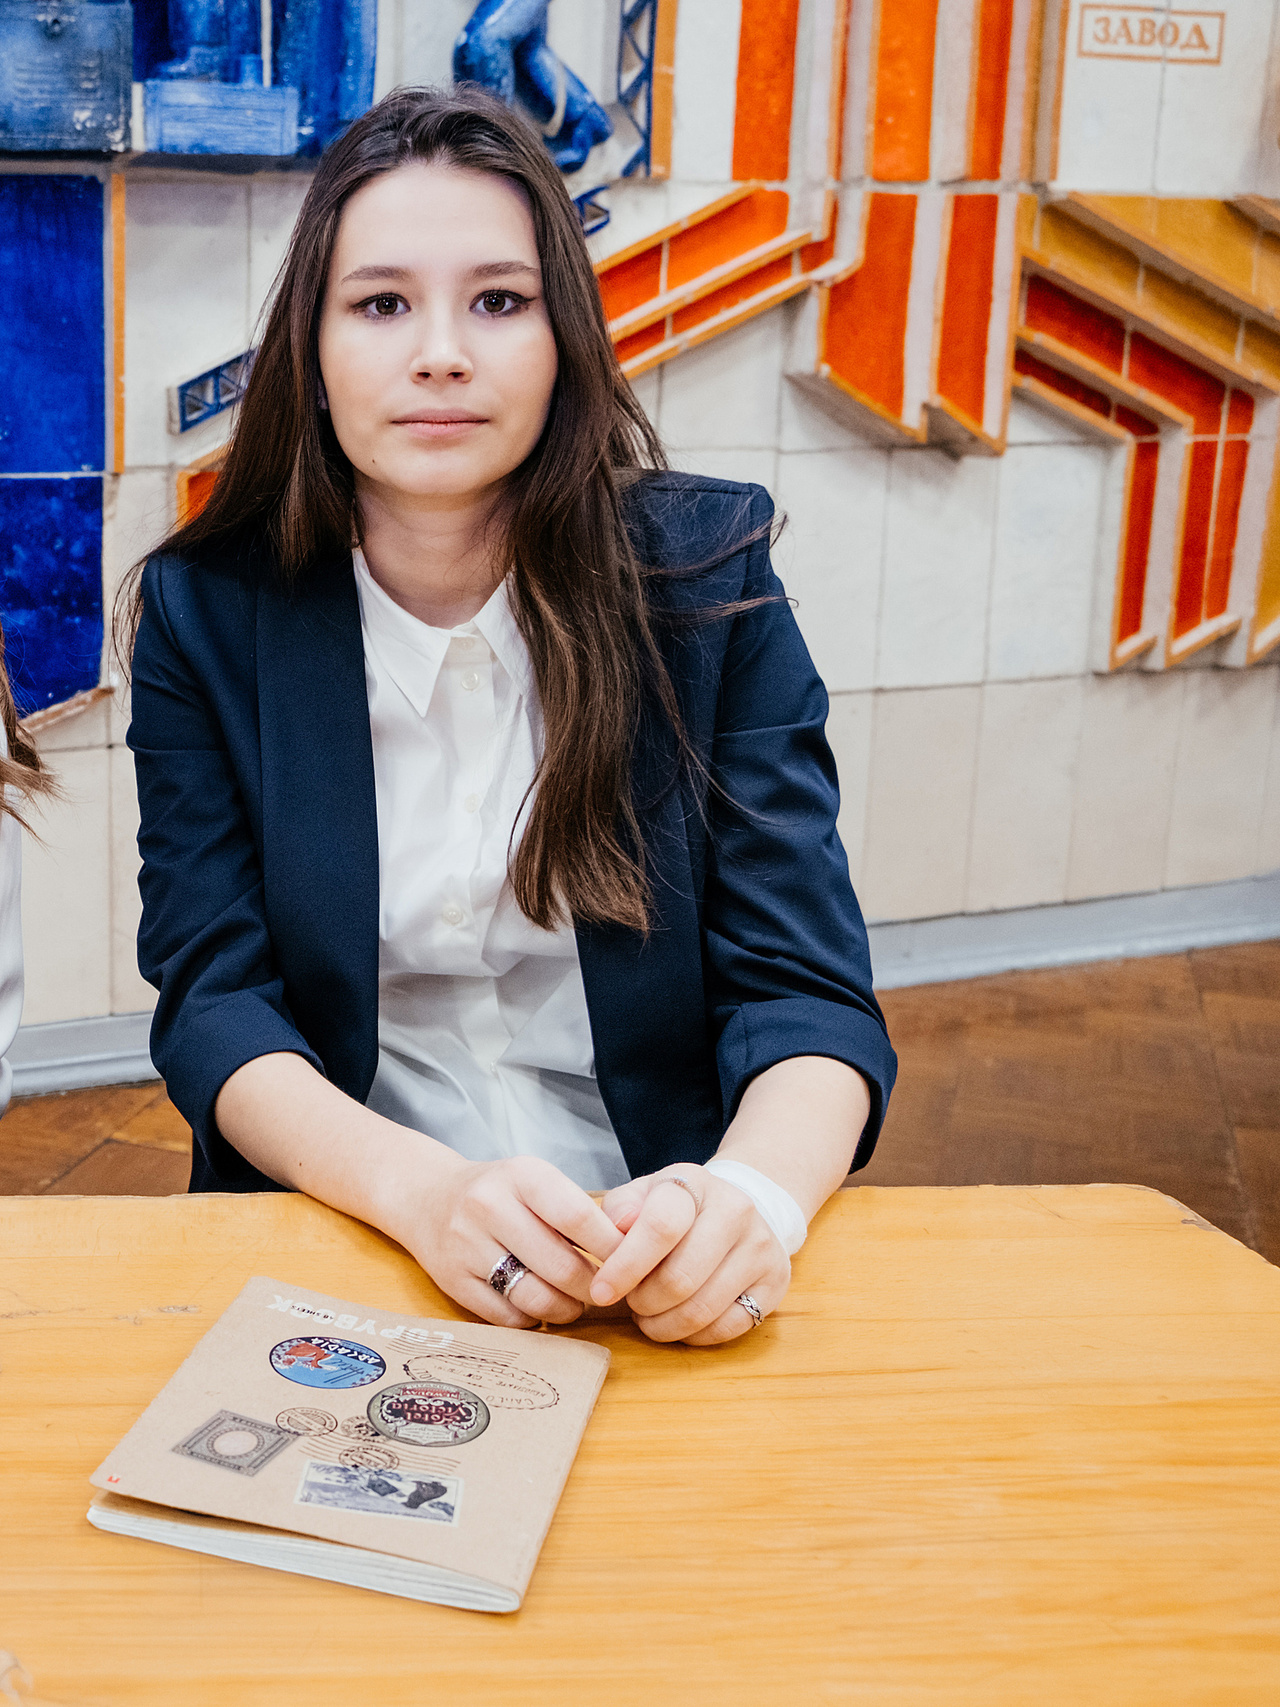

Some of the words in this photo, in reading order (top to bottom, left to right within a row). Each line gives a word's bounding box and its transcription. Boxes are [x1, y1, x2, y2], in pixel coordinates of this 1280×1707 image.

[1093, 16, 1210, 51] ЗАВОД
[265, 1295, 455, 1348] COPYBOOK
[310, 1336, 381, 1365] ARCADIA
[402, 1389, 459, 1400] NEWQUAY
[391, 1402, 467, 1417] Victoria
[404, 1410, 461, 1426] Hotel
